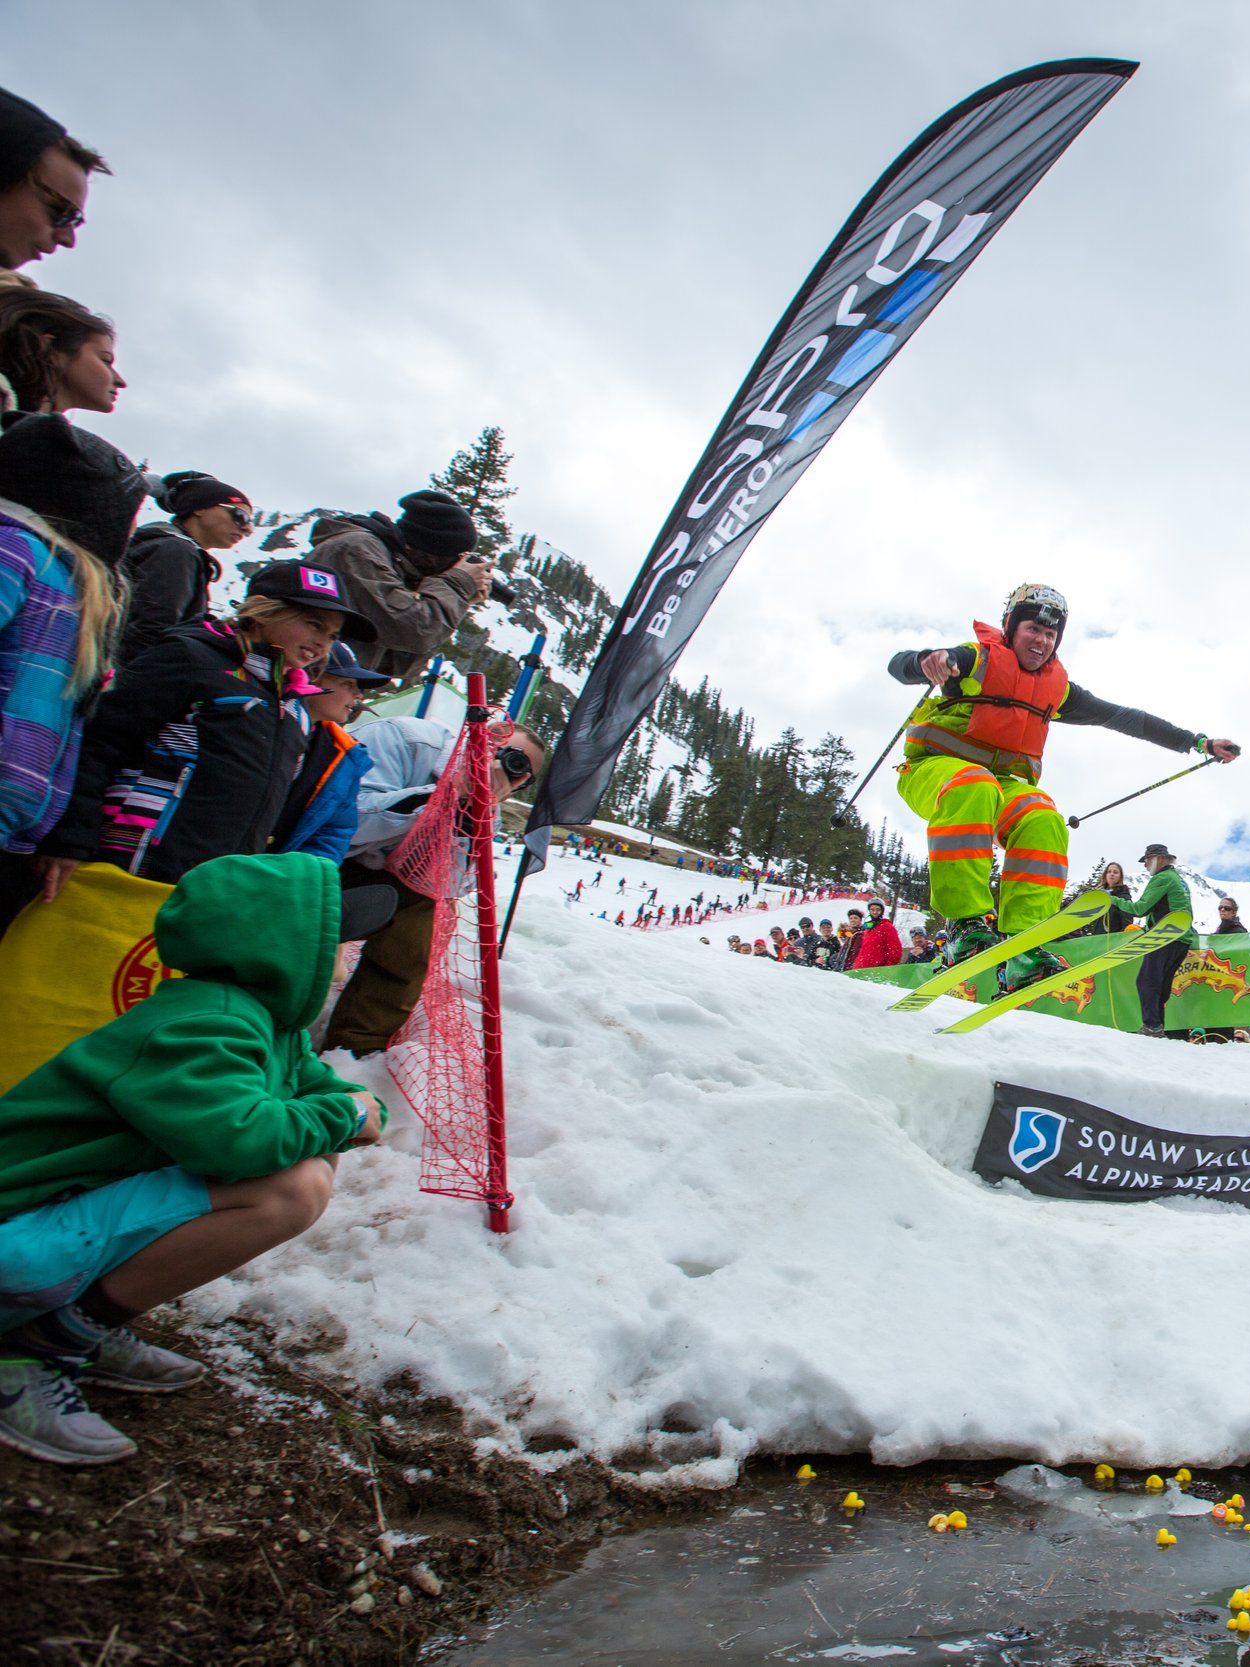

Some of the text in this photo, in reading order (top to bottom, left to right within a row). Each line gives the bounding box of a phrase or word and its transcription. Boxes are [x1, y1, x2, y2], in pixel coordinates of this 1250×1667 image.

[645, 594, 682, 639] Be
[676, 568, 698, 589] a
[1103, 923, 1185, 961] 4FRNT
[1078, 1126, 1186, 1165] SQUAW
[1065, 1162, 1164, 1190] ALPINE
